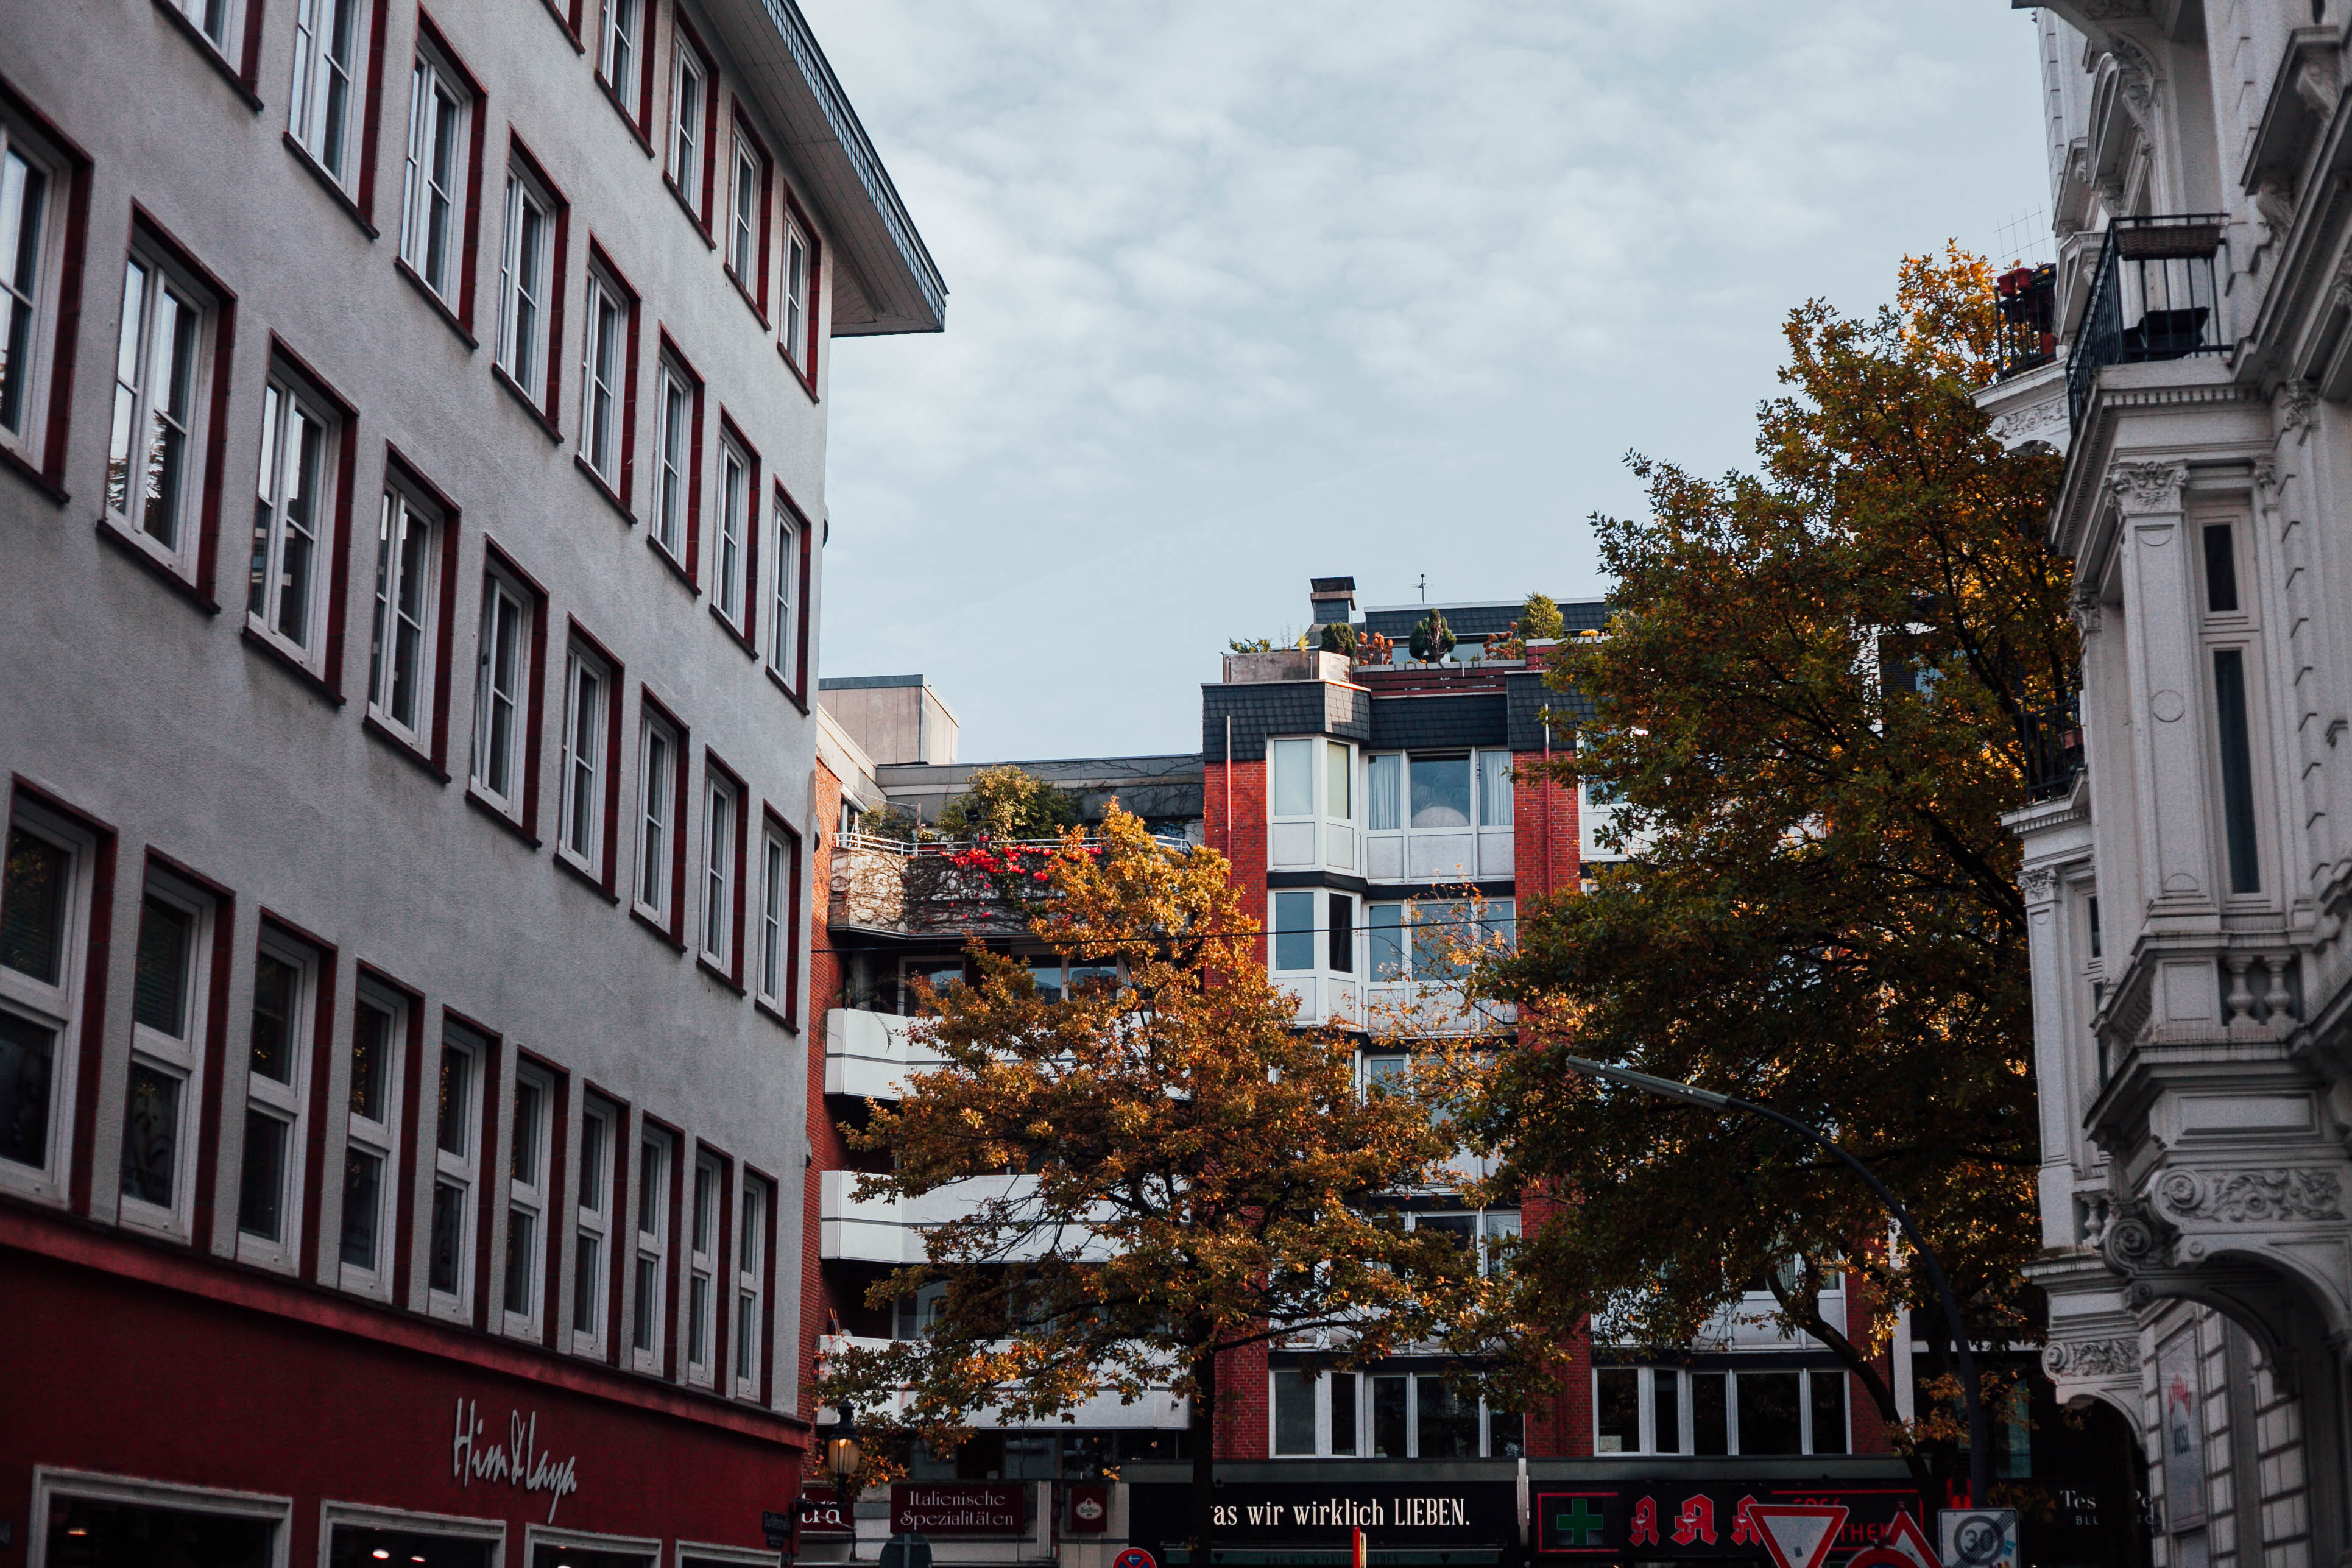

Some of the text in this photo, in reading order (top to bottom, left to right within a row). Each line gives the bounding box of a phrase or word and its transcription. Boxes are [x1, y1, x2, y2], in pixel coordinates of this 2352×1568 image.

[909, 1489, 1006, 1506] Italienische
[900, 1510, 1014, 1530] Spezialitäten
[1210, 1498, 1470, 1525] as wir wirklich LIEBEN.
[1965, 1530, 1994, 1552] 30
